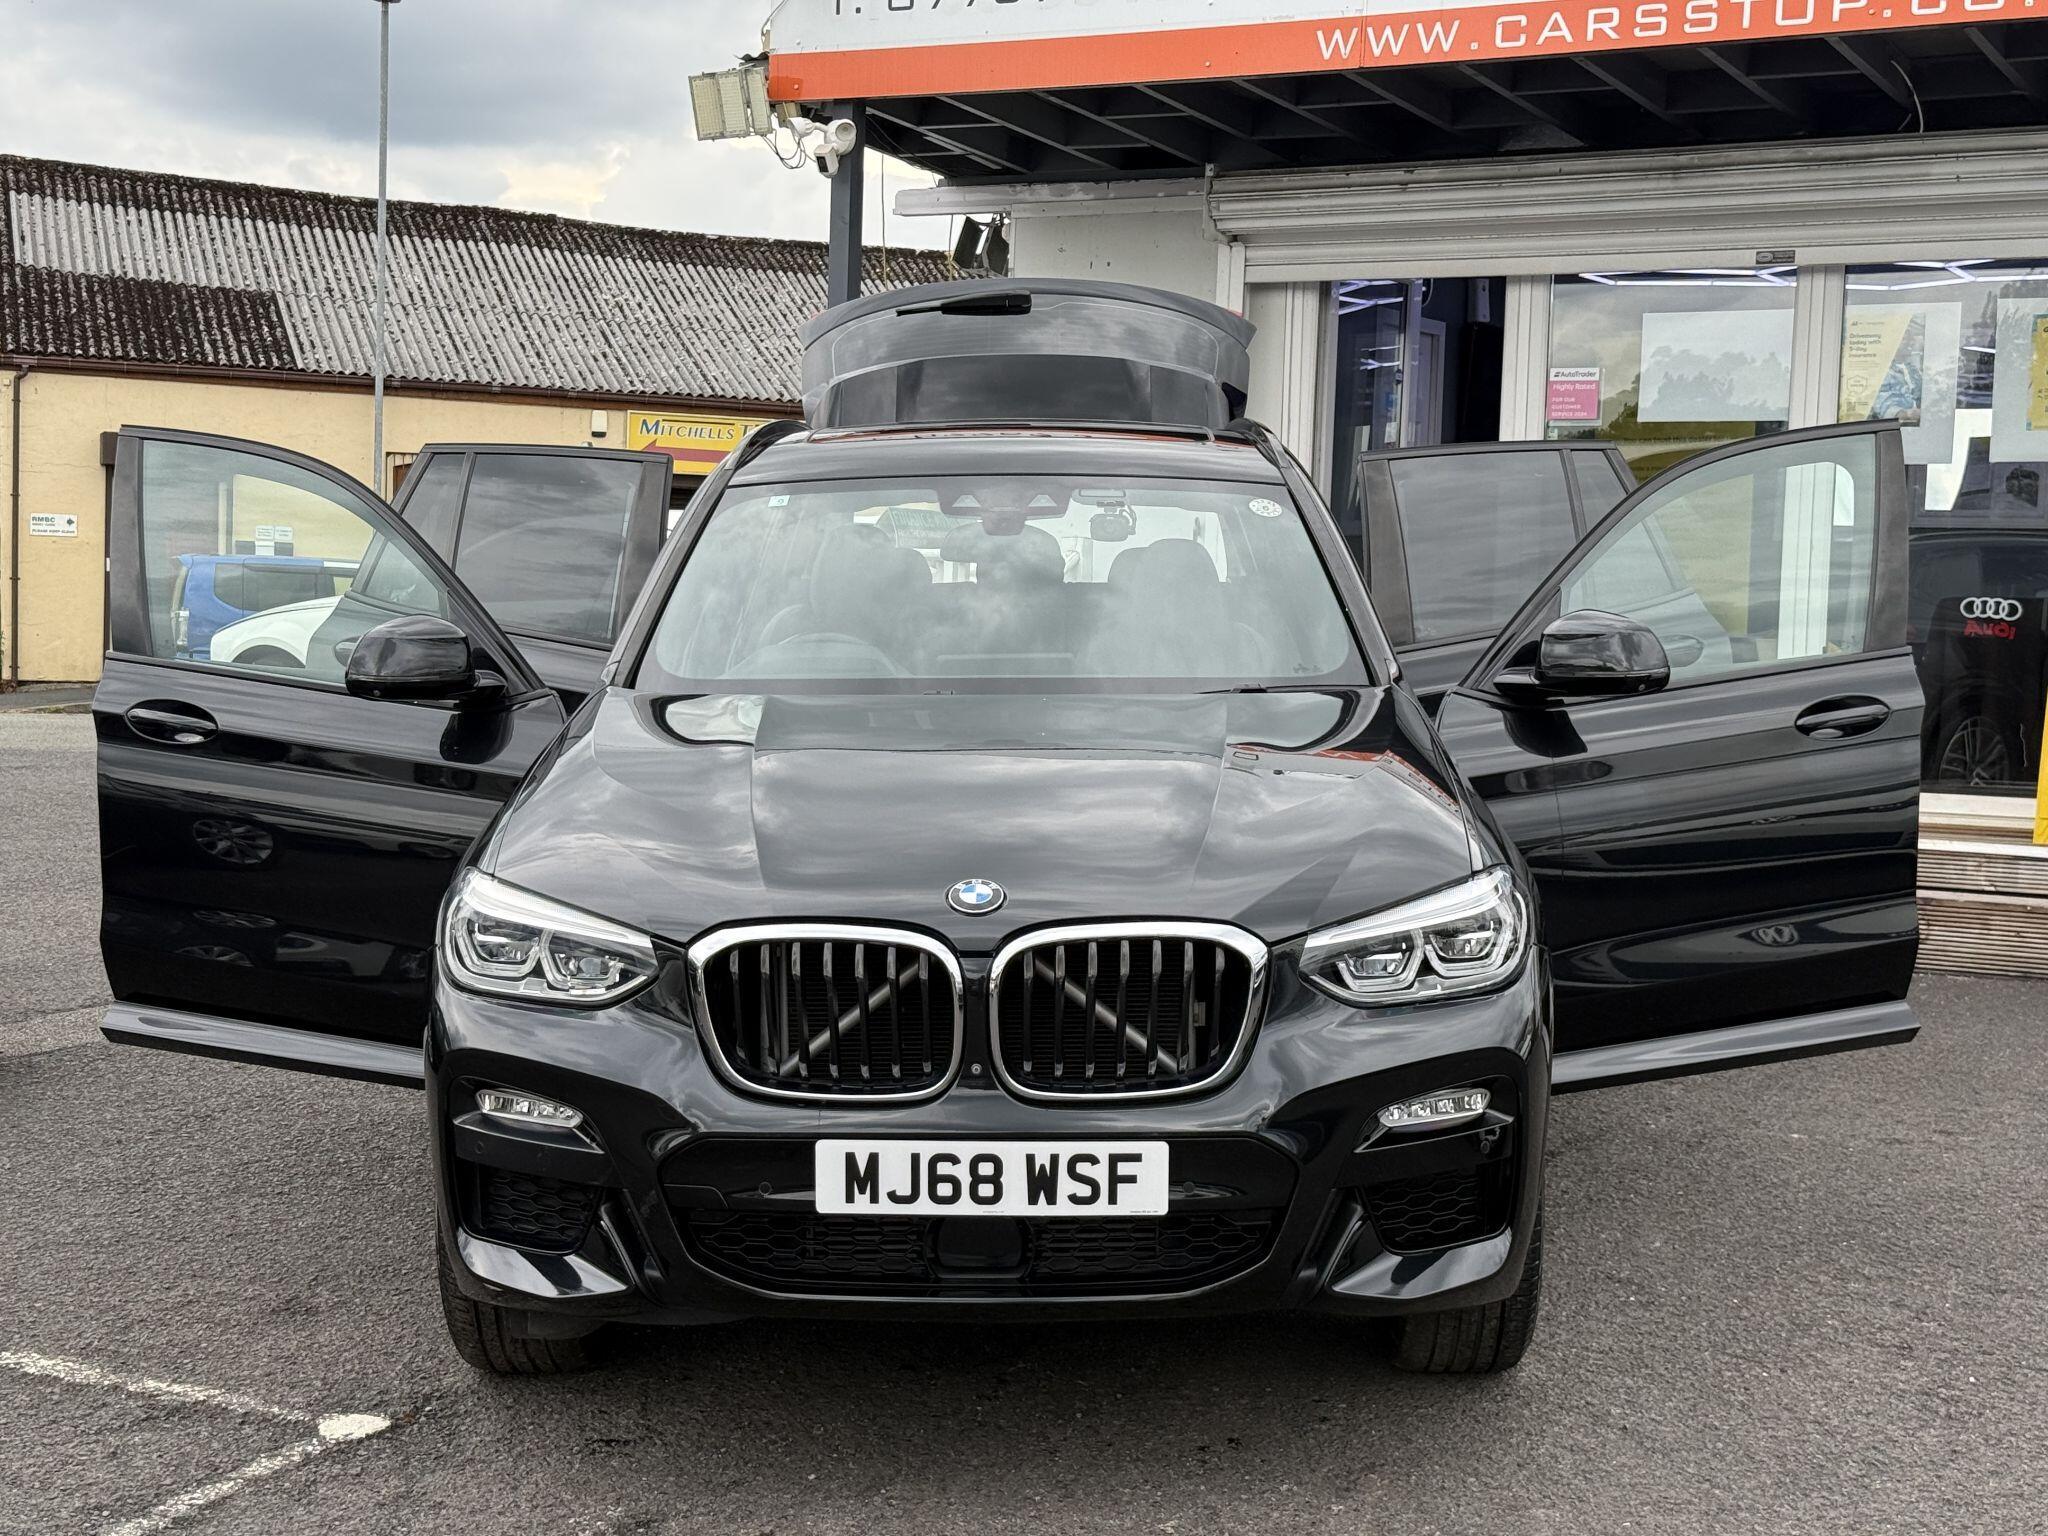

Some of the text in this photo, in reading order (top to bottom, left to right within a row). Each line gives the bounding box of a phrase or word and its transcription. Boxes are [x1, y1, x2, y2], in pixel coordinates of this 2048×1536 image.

[1552, 383, 1575, 391] Highly
[844, 1151, 1144, 1206] MJ68 WSF
